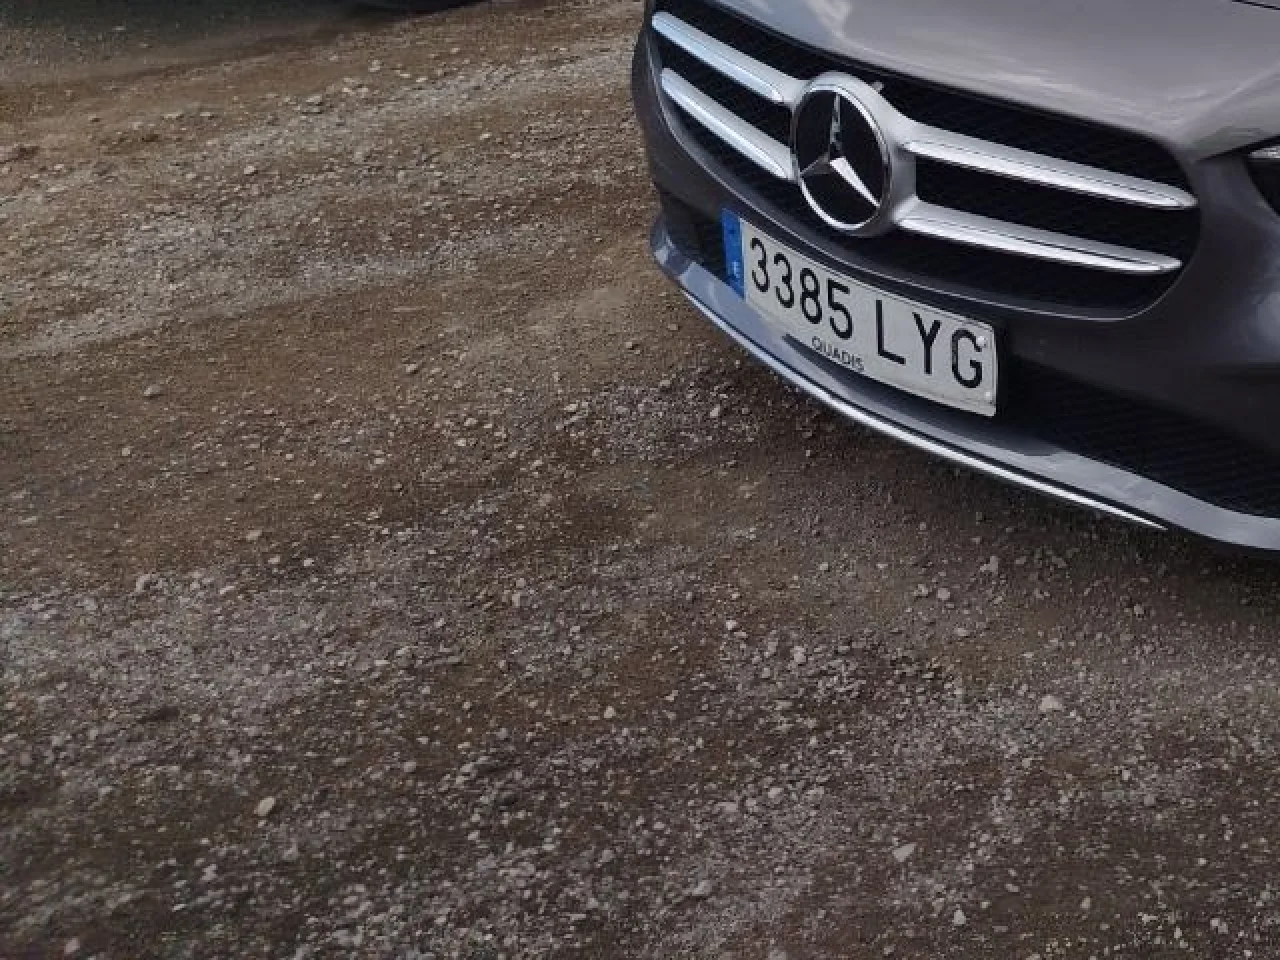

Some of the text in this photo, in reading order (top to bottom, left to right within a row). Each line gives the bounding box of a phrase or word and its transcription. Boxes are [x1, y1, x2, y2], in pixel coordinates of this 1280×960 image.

[749, 236, 984, 390] 3385 LYG
[810, 334, 866, 373] QUADIS
